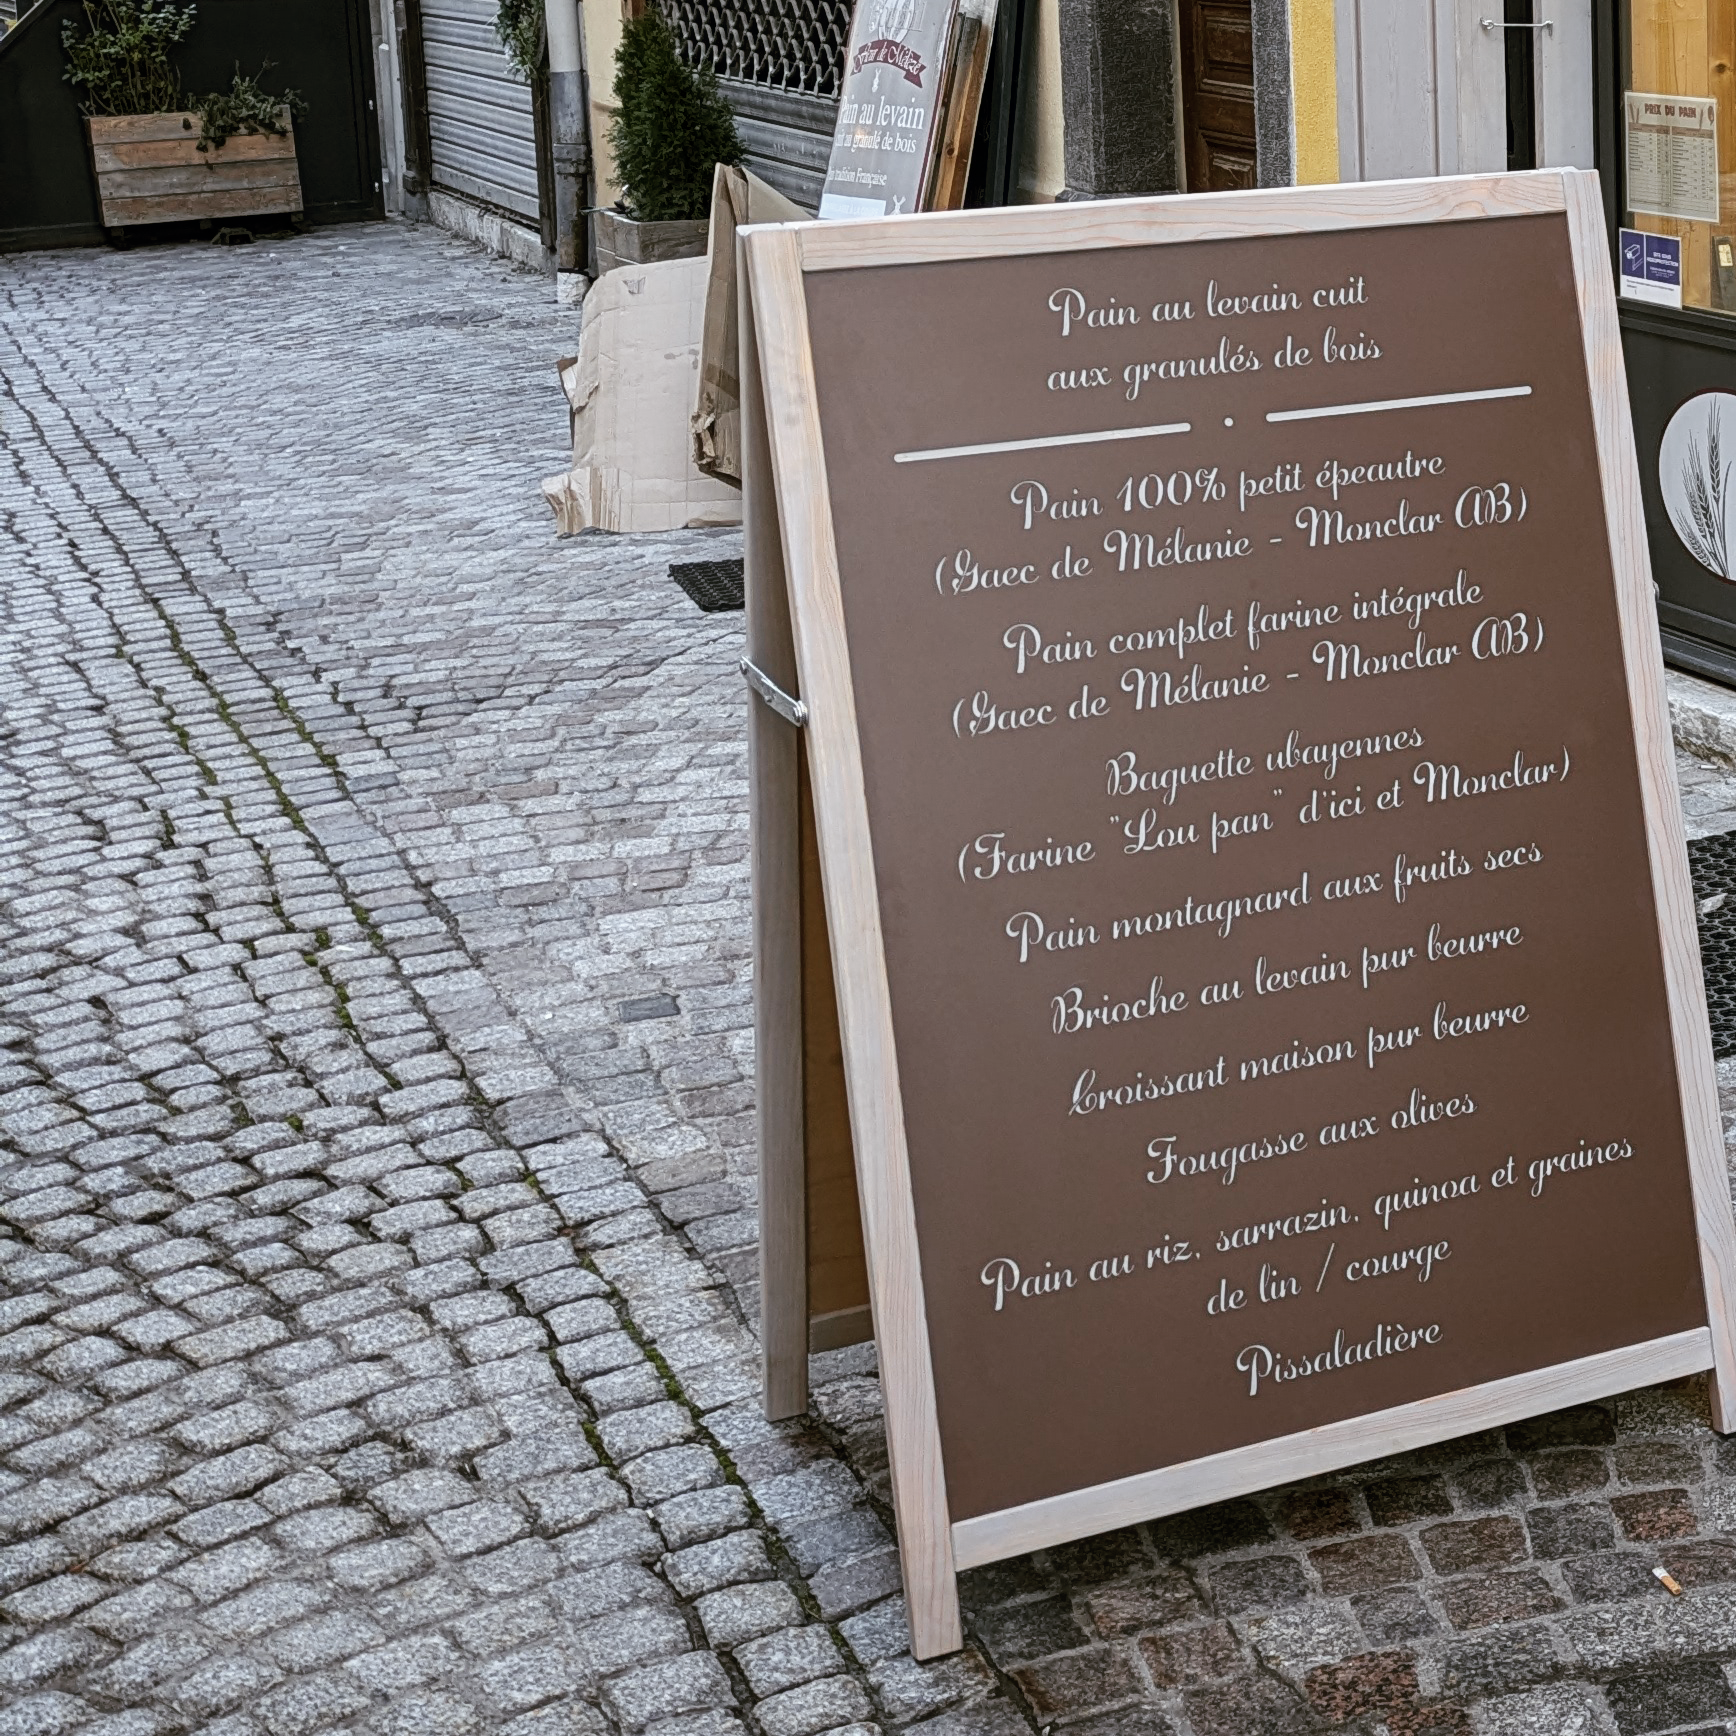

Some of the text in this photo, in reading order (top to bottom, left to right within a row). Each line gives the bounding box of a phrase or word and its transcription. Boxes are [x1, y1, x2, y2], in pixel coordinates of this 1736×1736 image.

[859, 103, 875, 126] au
[876, 95, 925, 130] levain
[894, 132, 917, 153] bois
[1048, 276, 1369, 337] Pain au levain cuit
[1047, 325, 1383, 401] aux granulés de bois
[1010, 450, 1446, 530] Pain 100% petit épeautre
[935, 548, 1040, 596] (Gaec
[1051, 545, 1089, 580] de
[1103, 526, 1253, 572] Mélanie
[1295, 498, 1444, 547] Monclar
[1002, 568, 1484, 674] Pain complet farine intégrale
[952, 690, 1057, 738] (Gaec
[1068, 684, 1110, 720] de
[1120, 663, 1270, 711] Mélanie
[1312, 631, 1461, 682] Monclar
[958, 832, 1096, 883] (Farine
[1376, 779, 1405, 810] et
[1413, 745, 1570, 803] Monclar)
[1105, 727, 1425, 806] Baguette ubayennes
[1005, 842, 1544, 963] Pain montagnard aux fruits secs
[1050, 922, 1524, 1034] Brioche au levain pur beurre
[1068, 1001, 1530, 1116] Croissant maison pur beurre
[1146, 1087, 1478, 1186] Fougasse aux olives
[980, 1257, 1078, 1312] Pain
[1089, 1254, 1135, 1282] au
[1374, 1174, 1481, 1231] quinoa
[1491, 1155, 1519, 1188] et
[1528, 1139, 1632, 1198] graines
[1207, 1278, 1248, 1315] de
[1259, 1263, 1302, 1303] lin
[1346, 1240, 1452, 1283] courge
[1236, 1323, 1444, 1397] Pissaladière
